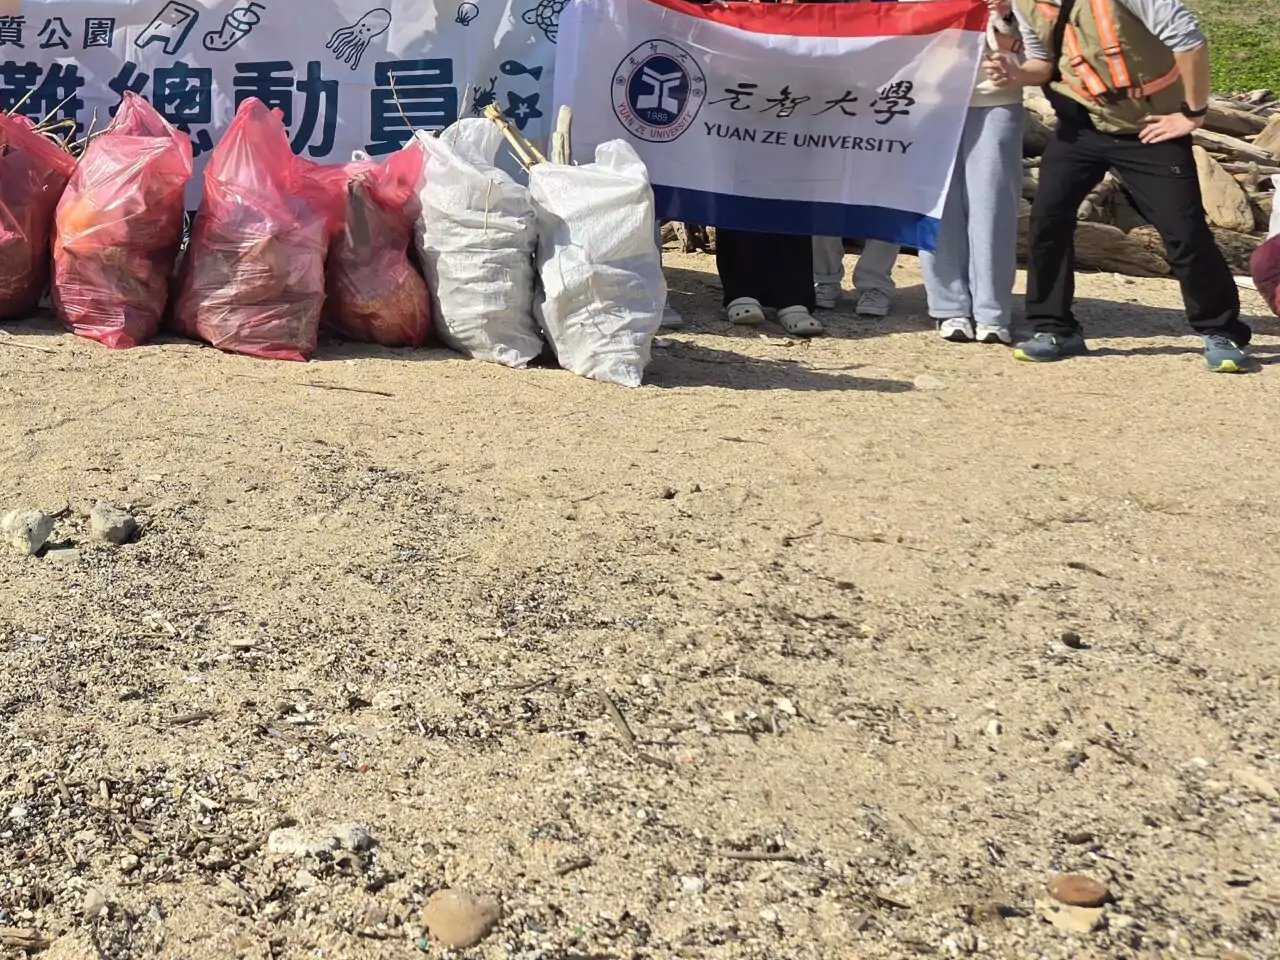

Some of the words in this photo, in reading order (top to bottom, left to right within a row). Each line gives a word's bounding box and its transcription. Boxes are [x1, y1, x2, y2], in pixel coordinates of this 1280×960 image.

[617, 101, 636, 127] YUAN
[634, 124, 647, 135] ZE
[650, 111, 692, 138] UNIVERSITY
[646, 110, 668, 121] 1989
[708, 80, 916, 125] 元智大學
[704, 122, 757, 143] YUAN
[761, 130, 788, 146] ZE
[793, 133, 914, 155] UNIVERSITY
